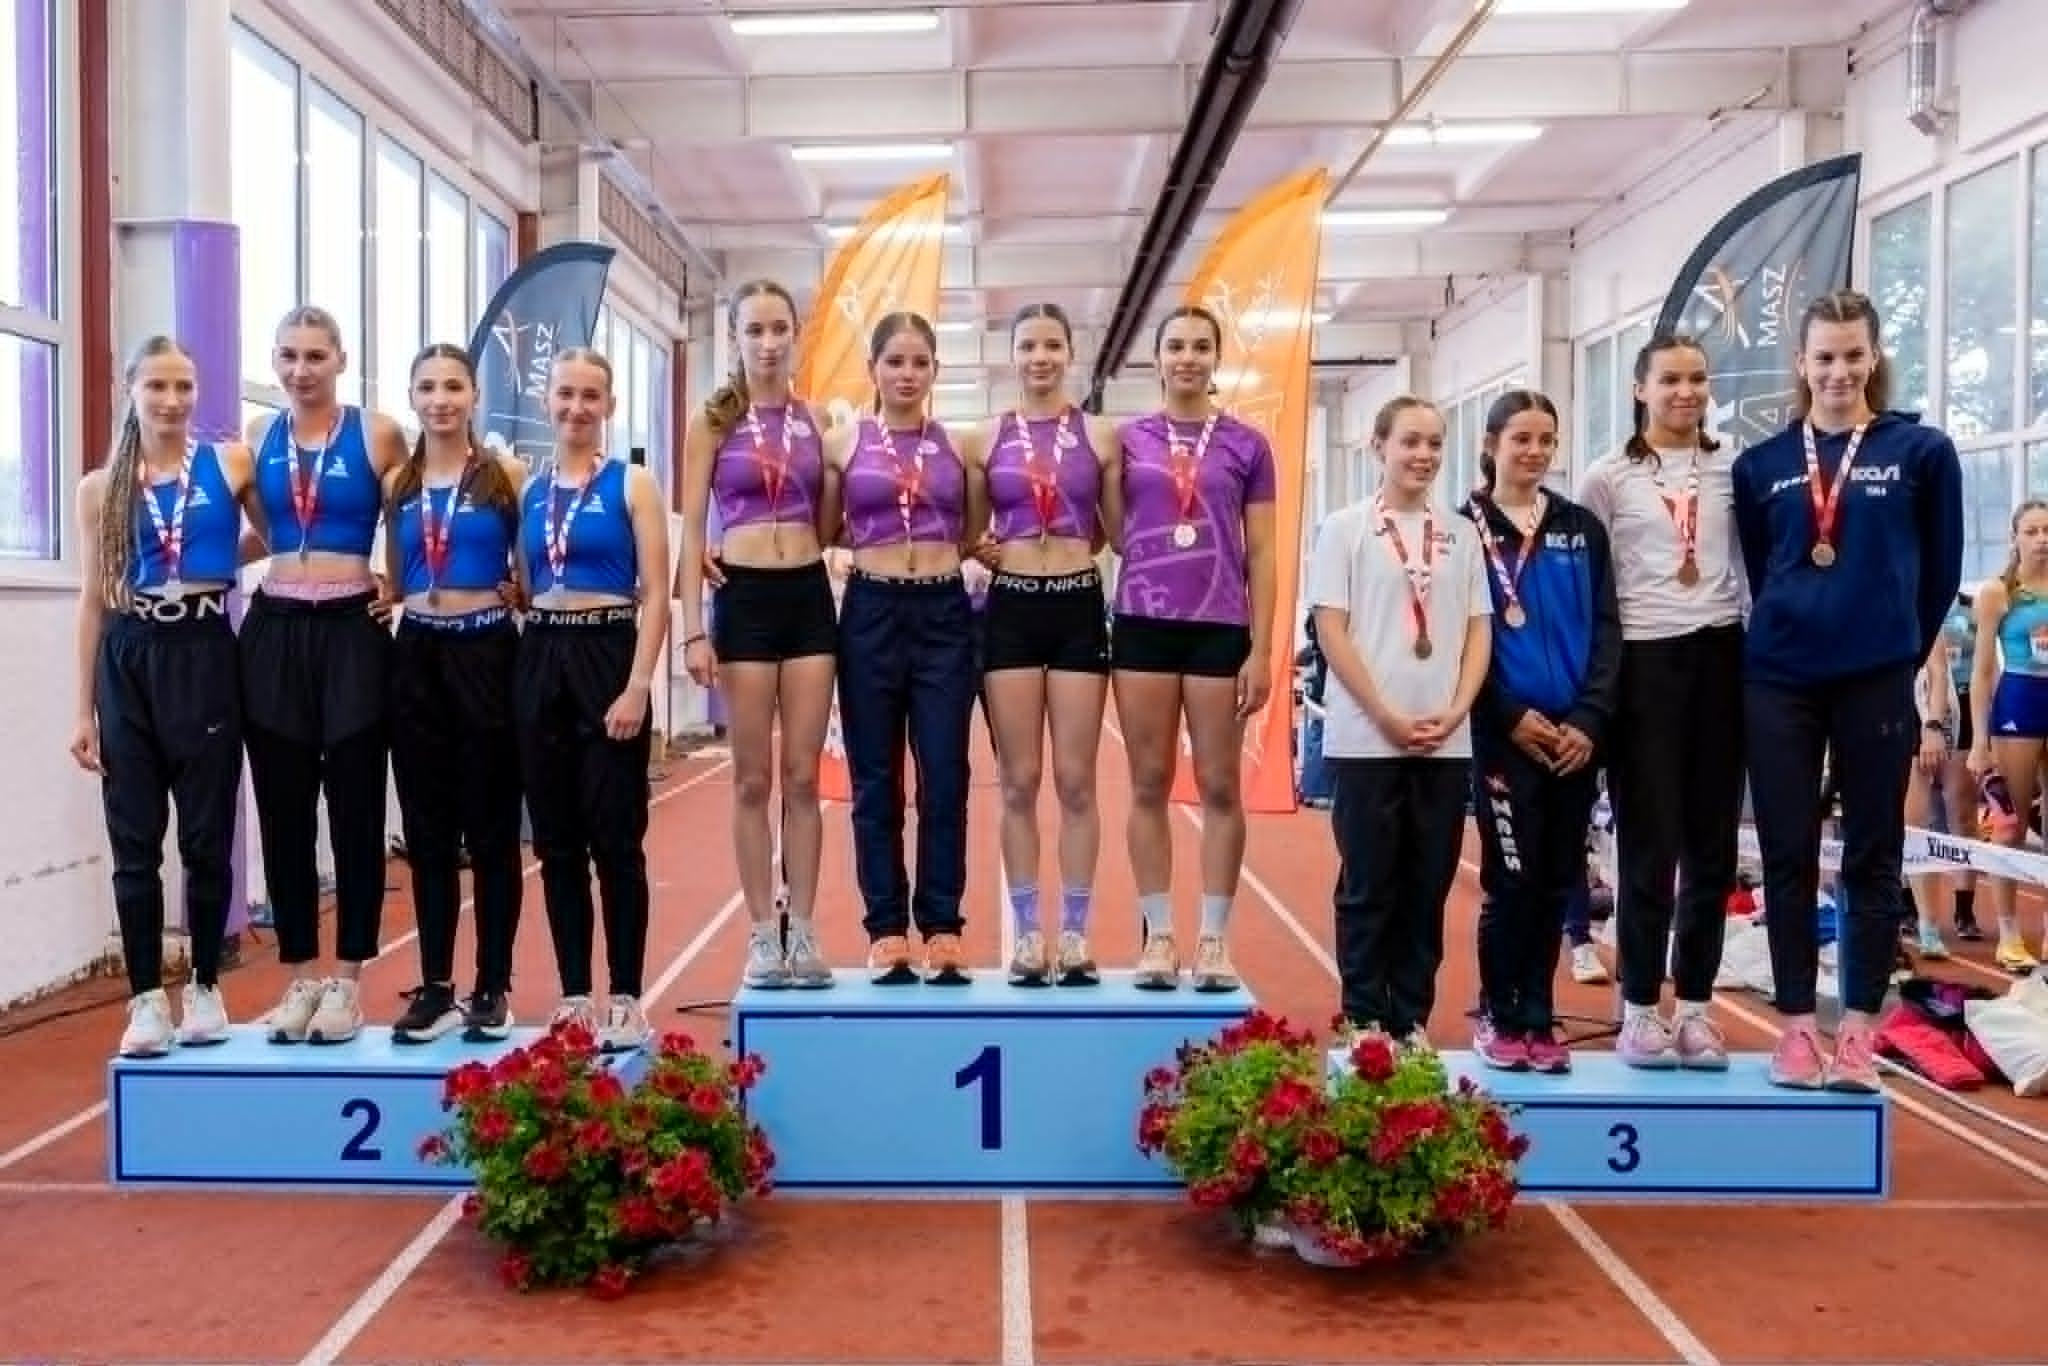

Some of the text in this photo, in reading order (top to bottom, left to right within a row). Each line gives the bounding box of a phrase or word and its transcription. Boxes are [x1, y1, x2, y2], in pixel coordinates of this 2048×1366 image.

[1758, 263, 1788, 347] MASZ
[525, 321, 555, 396] MASZ
[340, 1098, 382, 1161] 2
[955, 1045, 1003, 1151] 1
[1607, 1122, 1641, 1173] 3
